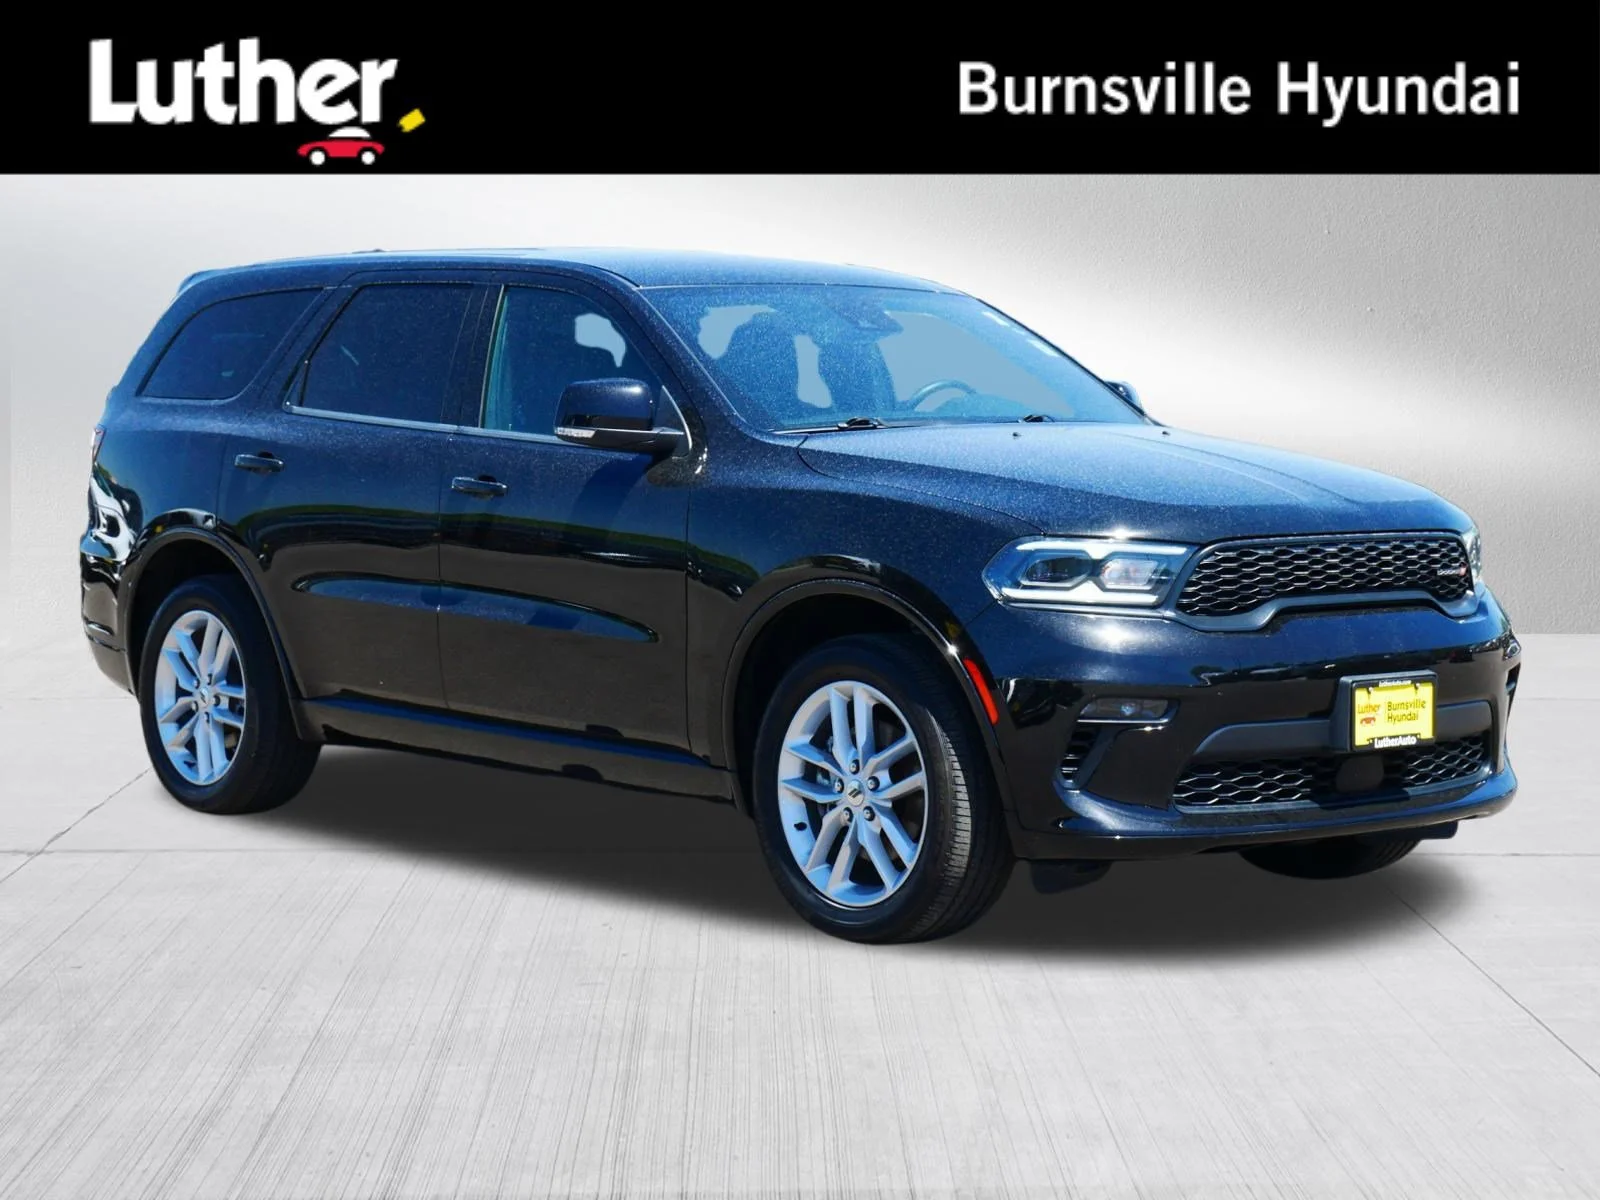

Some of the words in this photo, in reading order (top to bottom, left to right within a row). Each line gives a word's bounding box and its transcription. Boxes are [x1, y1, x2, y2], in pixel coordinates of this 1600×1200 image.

[1357, 703, 1381, 714] Luther
[1387, 700, 1427, 711] Burnsville
[1387, 712, 1419, 724] Hyundai
